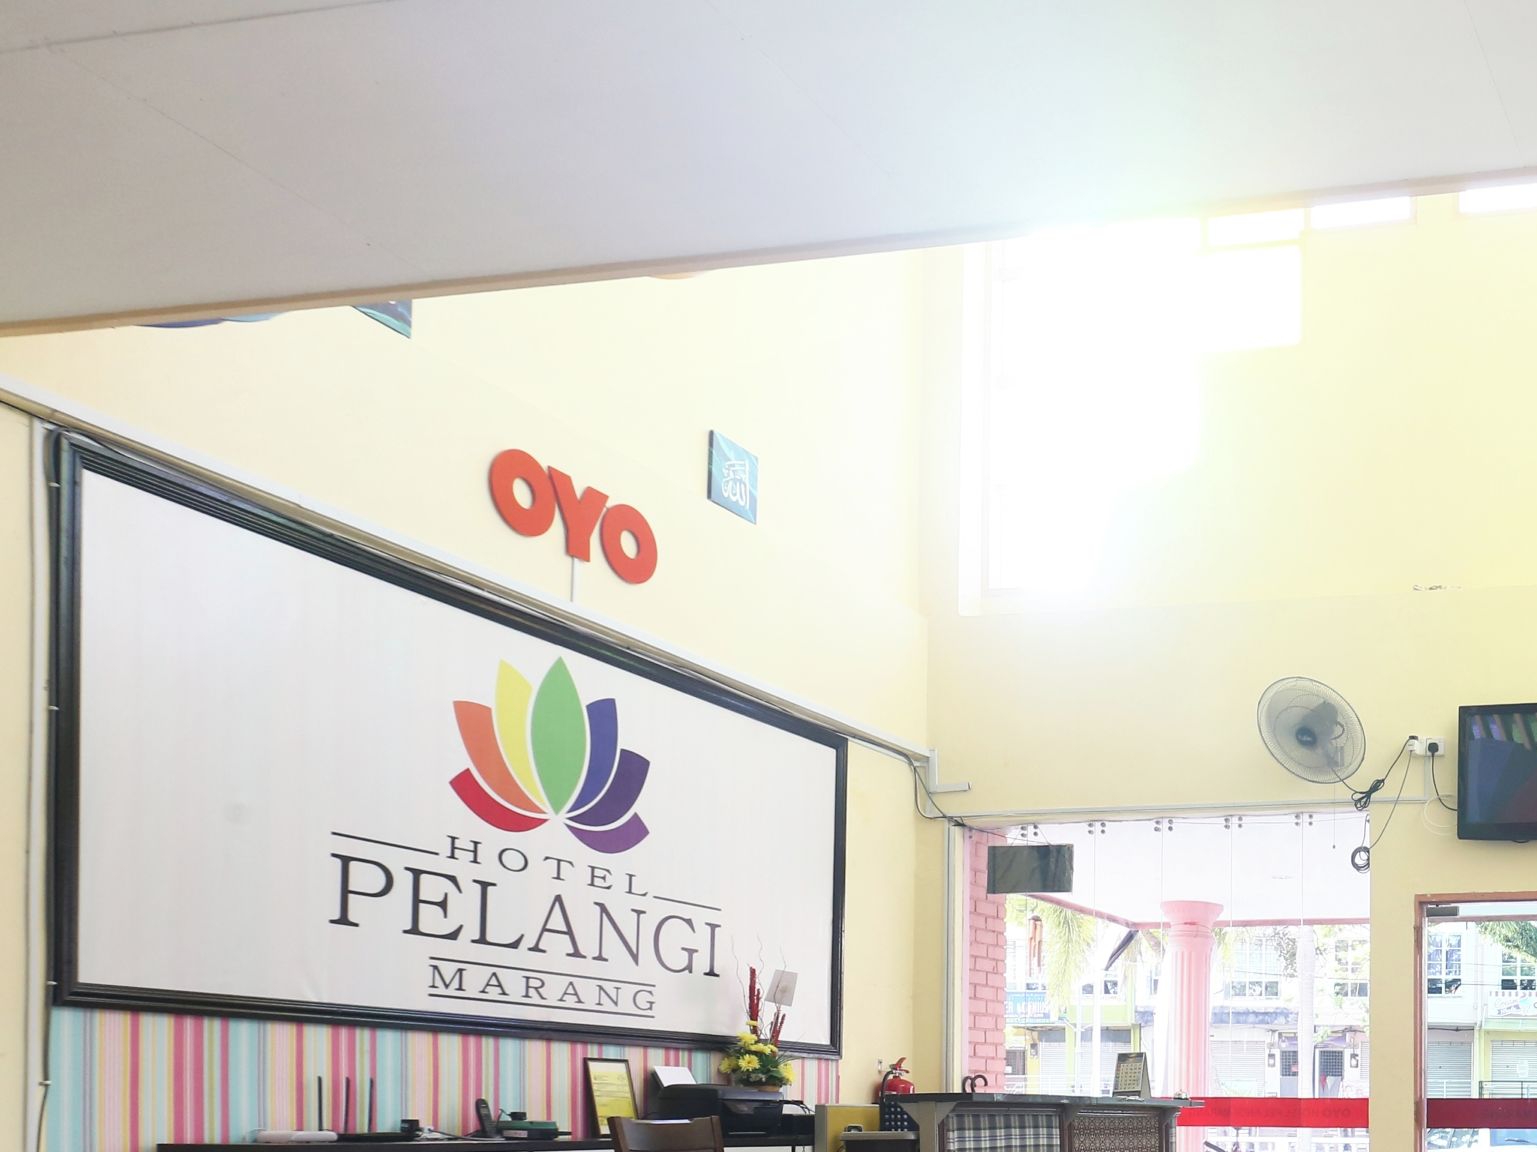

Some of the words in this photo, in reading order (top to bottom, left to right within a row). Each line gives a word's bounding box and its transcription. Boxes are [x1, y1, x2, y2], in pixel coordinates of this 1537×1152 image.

[488, 448, 657, 584] OYO
[446, 835, 649, 897] HOTEL
[328, 852, 721, 978] PELANGI
[428, 964, 656, 1011] MARANG
